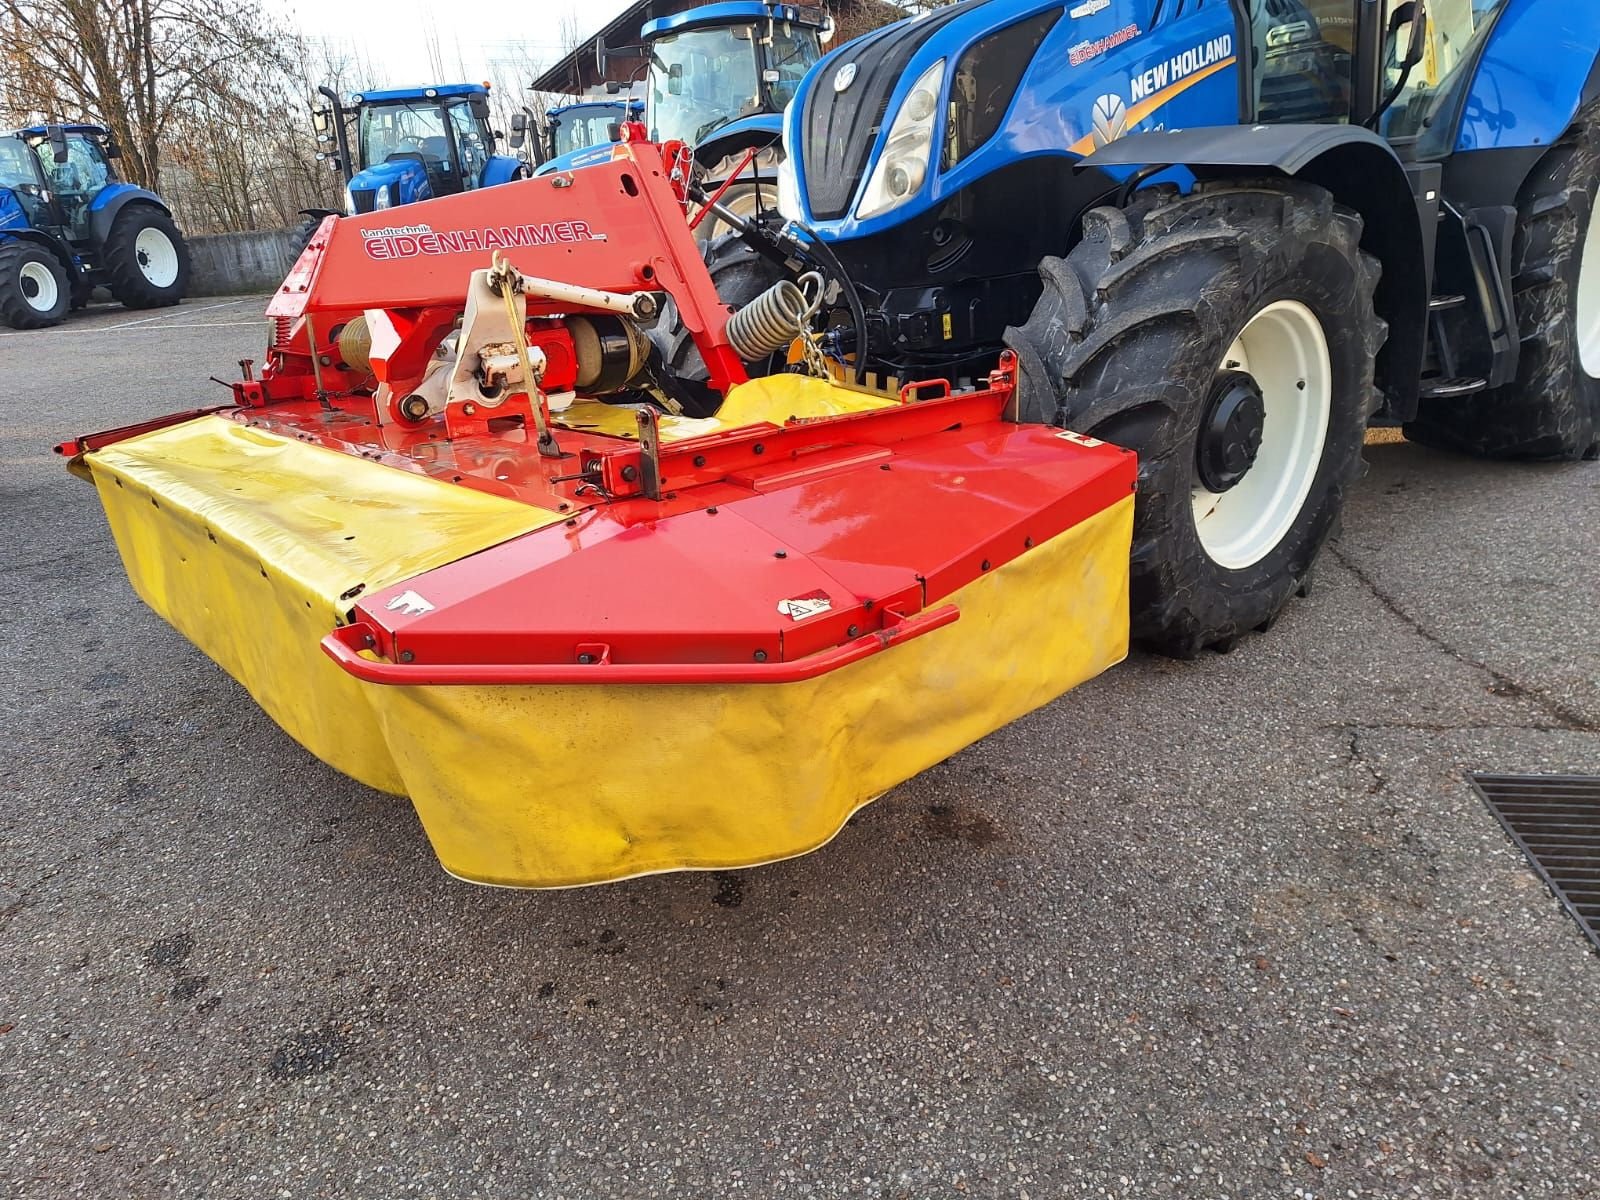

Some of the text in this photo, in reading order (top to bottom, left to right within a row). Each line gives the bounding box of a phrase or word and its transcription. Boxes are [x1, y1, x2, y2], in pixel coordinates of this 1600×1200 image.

[1069, 24, 1138, 67] EIDENHAMMER
[1130, 34, 1232, 103] NEW HOLLAND
[361, 224, 432, 238] Landtechnik
[365, 220, 594, 260] EIDENHAMMER
